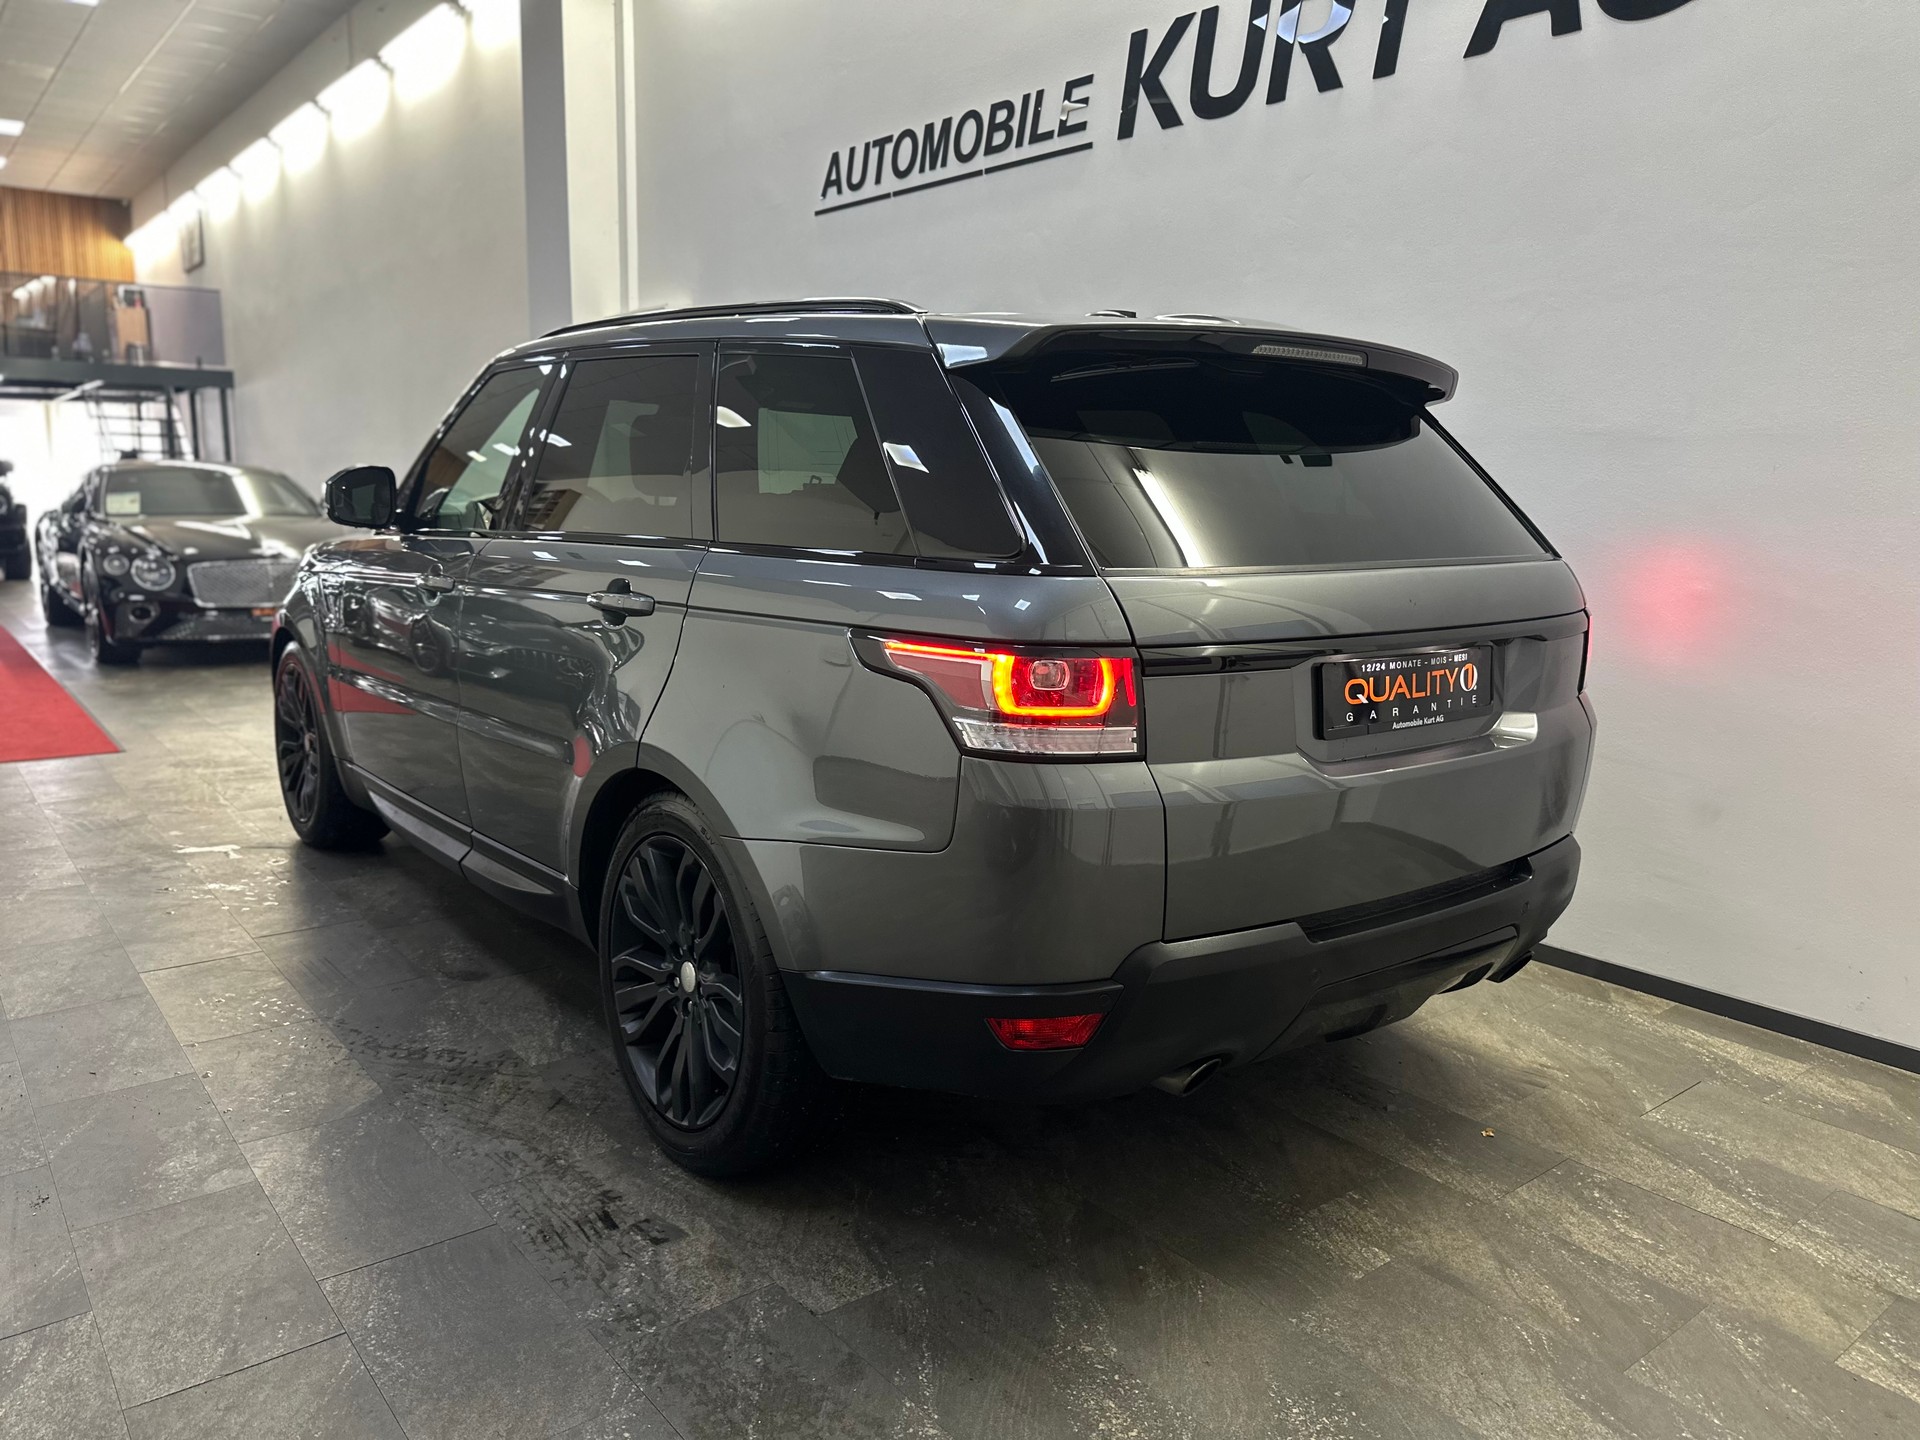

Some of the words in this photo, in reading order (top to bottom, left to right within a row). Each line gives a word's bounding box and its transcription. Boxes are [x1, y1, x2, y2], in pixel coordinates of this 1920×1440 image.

[821, 74, 1094, 199] AUTOMOBILE
[1361, 662, 1386, 672] 12/24
[1389, 659, 1422, 670] MONATE
[1430, 655, 1447, 666] MOIS
[1454, 653, 1468, 662] MESI
[1346, 694, 1477, 722] GARANTIE
[1392, 718, 1423, 730] Automobile
[1424, 716, 1436, 725] Kurt
[1436, 714, 1445, 722] AG
